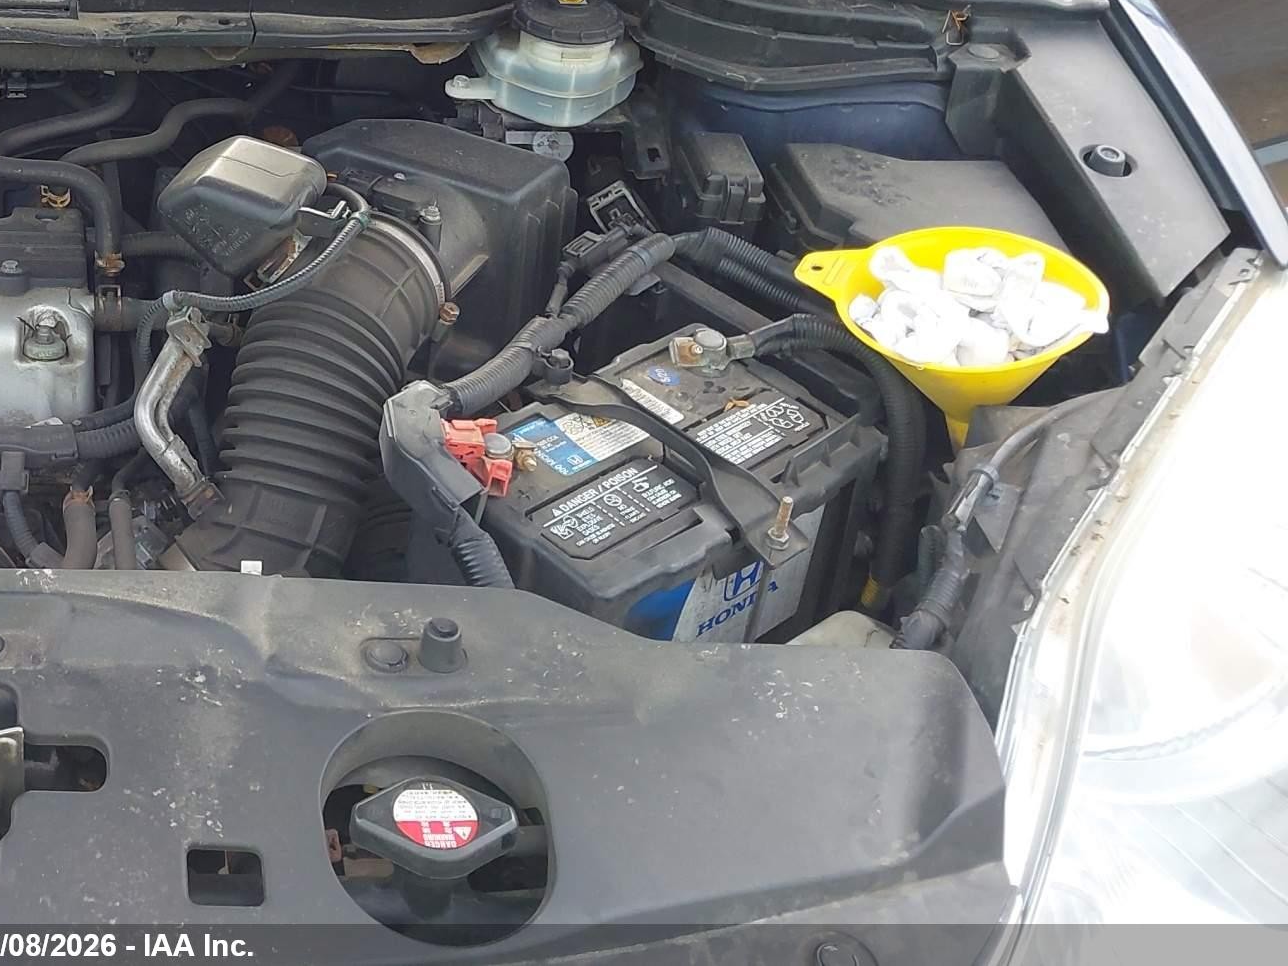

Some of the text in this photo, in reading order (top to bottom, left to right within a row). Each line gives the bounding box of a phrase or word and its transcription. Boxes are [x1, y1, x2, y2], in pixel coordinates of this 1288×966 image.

[559, 488, 599, 511] DANGER
[602, 467, 639, 488] POISON
[424, 841, 457, 849] DANGER
